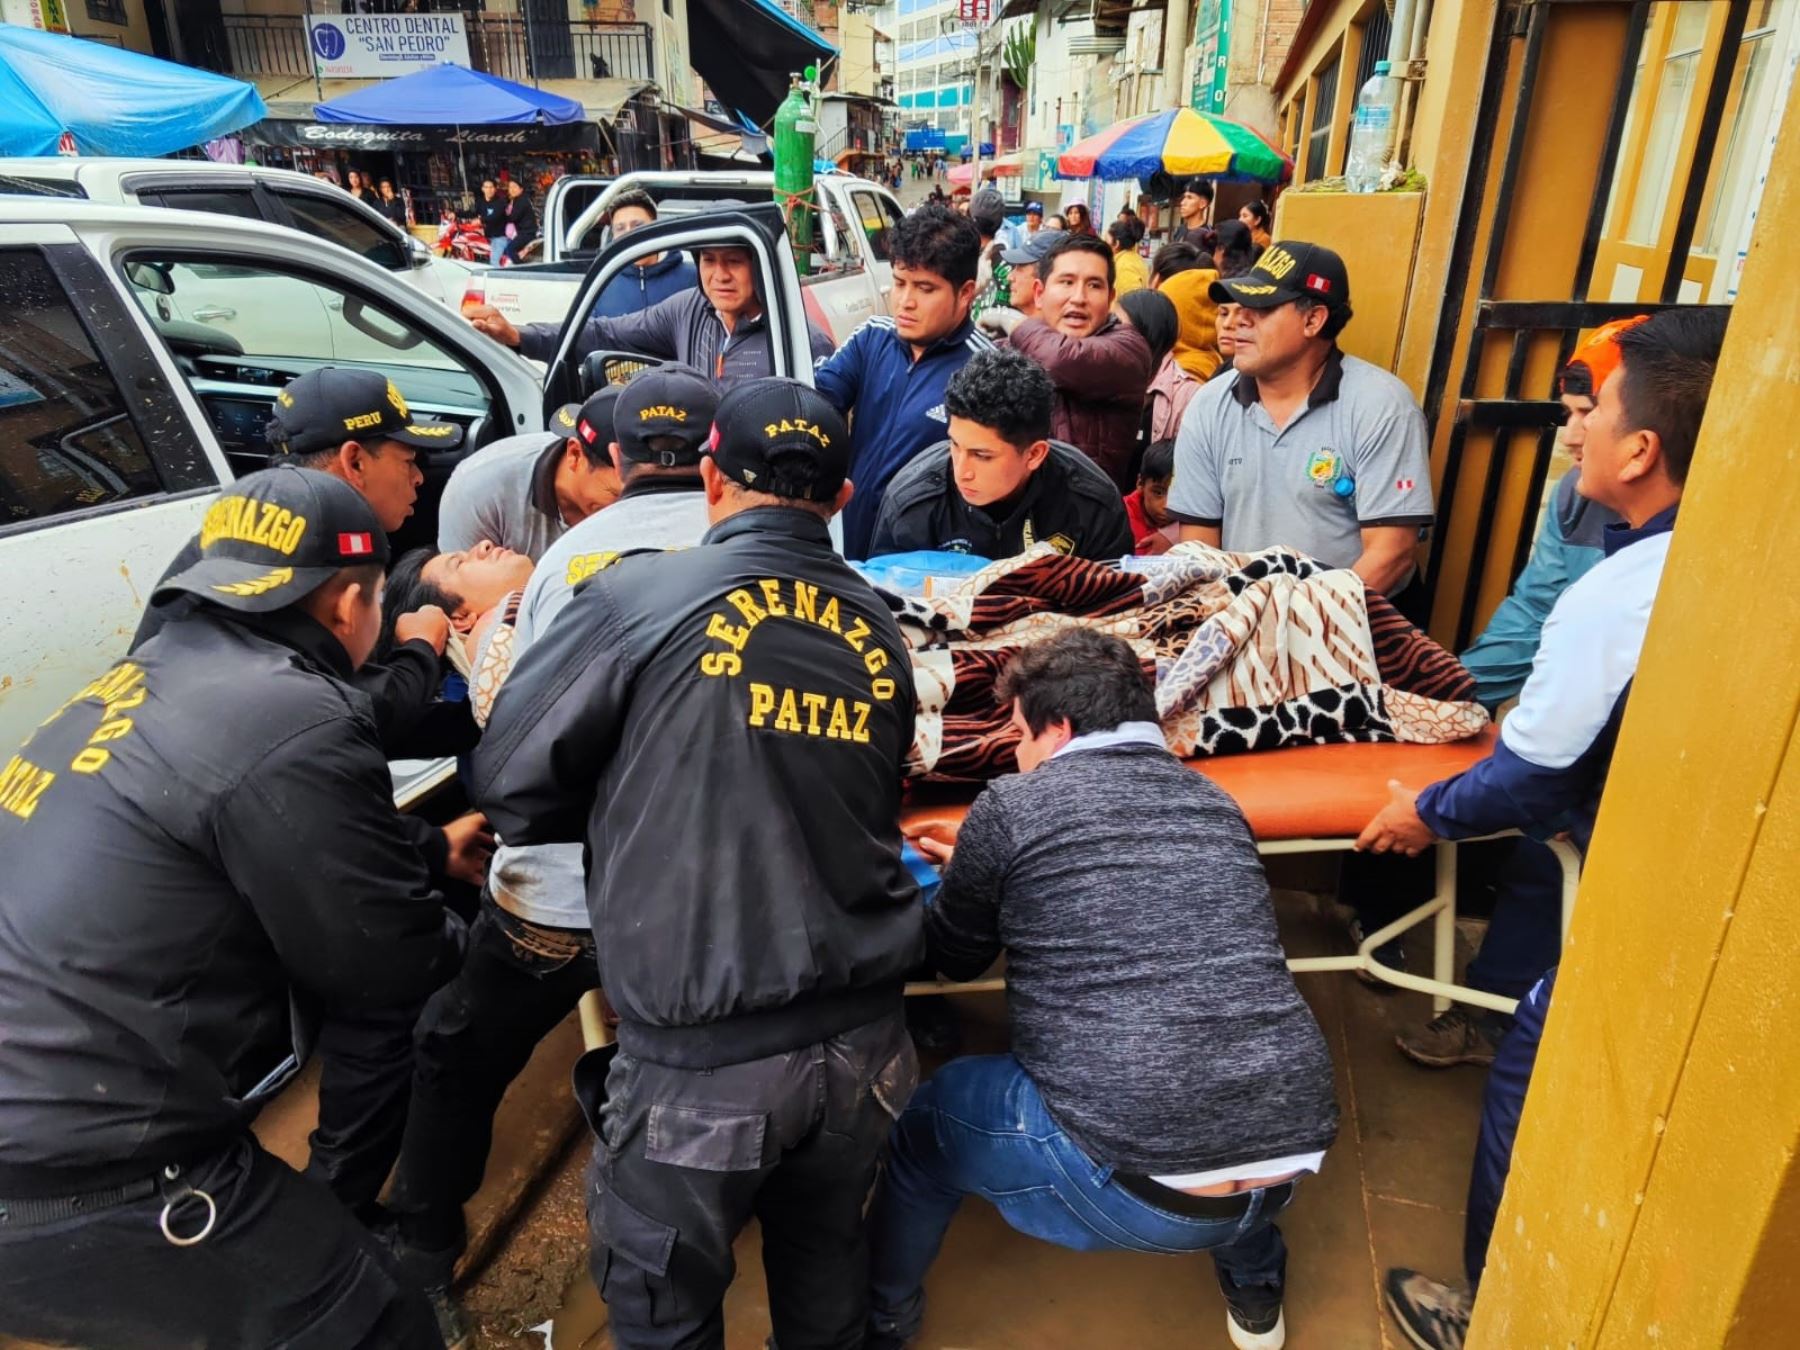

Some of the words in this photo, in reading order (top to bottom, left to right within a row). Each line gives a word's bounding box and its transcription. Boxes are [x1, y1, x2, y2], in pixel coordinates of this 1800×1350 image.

[345, 17, 400, 35] CENTRO
[405, 17, 459, 34] DENTAL
[359, 36, 394, 52] "SAN
[399, 36, 450, 52] PEDRO"
[304, 126, 425, 144] Bodeguita
[343, 411, 383, 431] PERU
[639, 405, 688, 422] PATAZ
[764, 418, 831, 448] PATAZ
[701, 579, 896, 700] SERENAZGO
[748, 683, 871, 744] PATAZ
